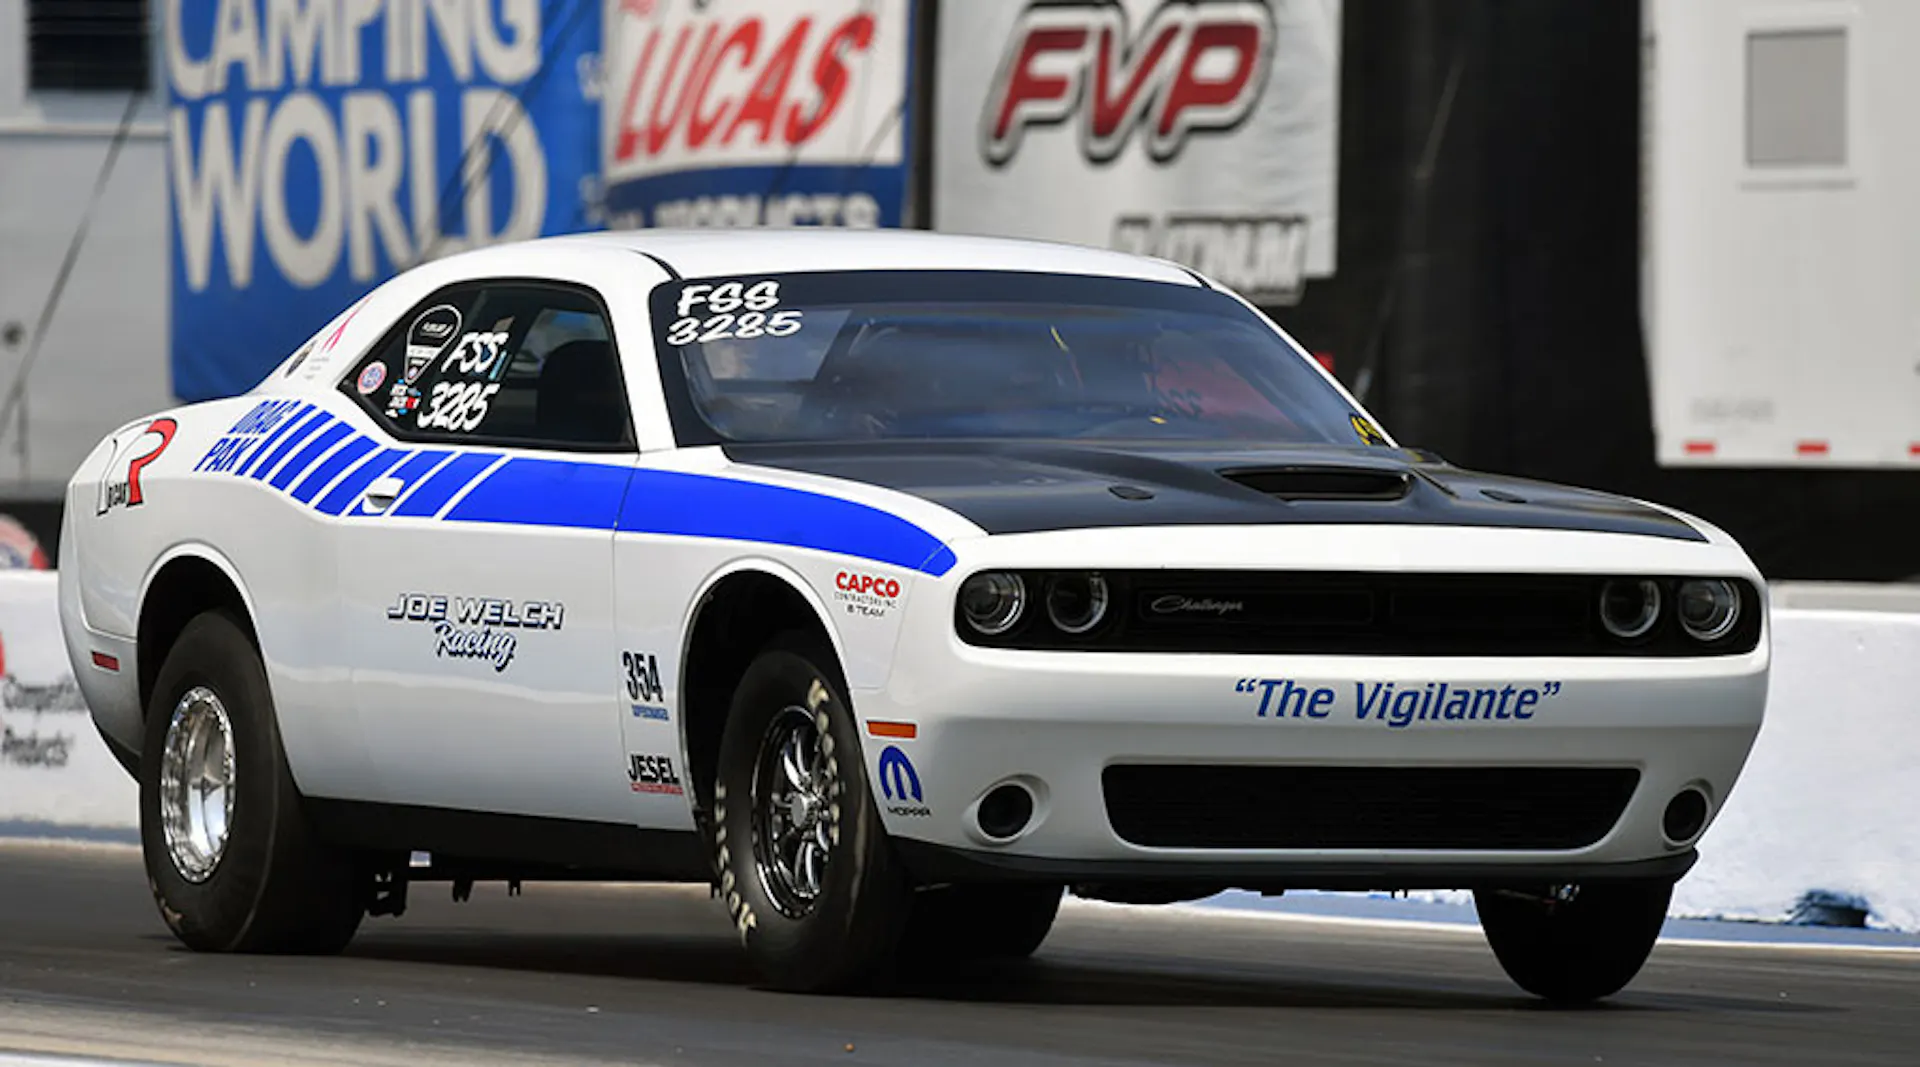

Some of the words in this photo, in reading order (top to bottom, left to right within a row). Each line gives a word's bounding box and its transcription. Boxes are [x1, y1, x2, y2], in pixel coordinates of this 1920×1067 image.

[167, 0, 541, 97] CAMPING
[614, 12, 874, 160] LUCAS
[984, 10, 1269, 156] FVP
[172, 90, 546, 290] WORLD
[677, 281, 780, 317] FSS
[666, 310, 803, 345] 3285
[441, 332, 510, 373] FSS
[417, 381, 500, 432] 3285
[193, 437, 259, 472] PAK
[836, 571, 900, 598] CAPCO
[388, 594, 448, 620] JOE
[456, 597, 564, 630] WELCH
[434, 619, 516, 673] Racing
[623, 651, 664, 702] 354
[628, 754, 680, 785] JESEL
